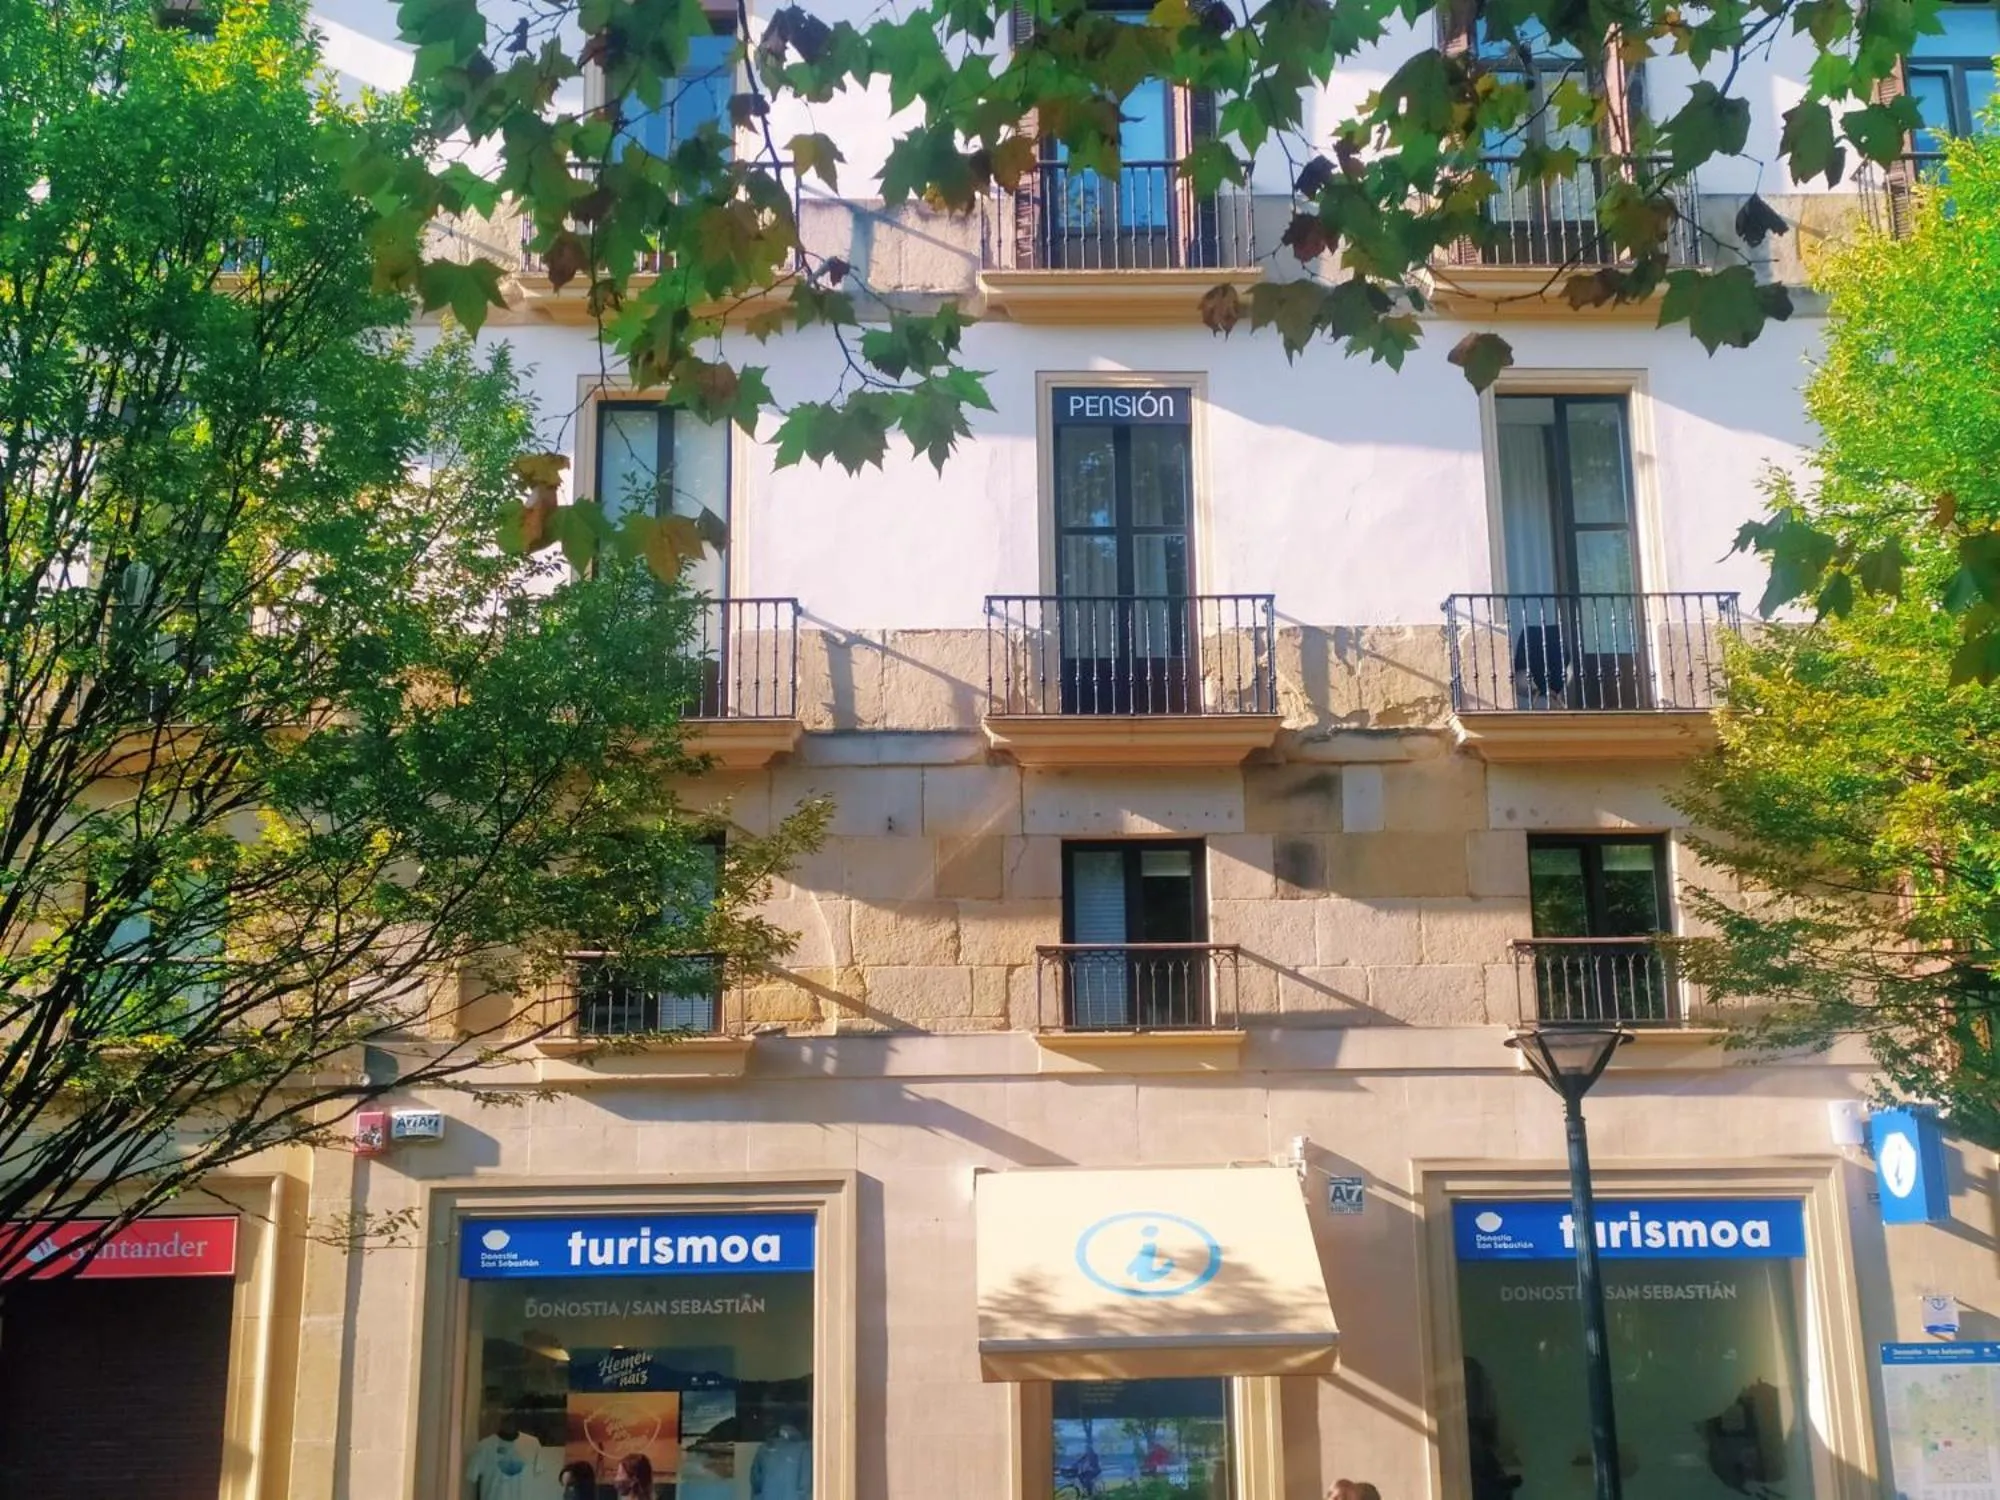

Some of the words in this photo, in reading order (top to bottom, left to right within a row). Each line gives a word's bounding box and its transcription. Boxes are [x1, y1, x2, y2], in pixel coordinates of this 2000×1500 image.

[1070, 391, 1174, 417] PENSIÓN
[69, 1231, 208, 1260] Sntander
[567, 1227, 781, 1266] turismoa
[481, 1260, 496, 1268] San
[1605, 1285, 1640, 1301] SAN
[1642, 1281, 1737, 1300] SEBASTIÁN
[525, 1300, 620, 1319] DONOSTIA
[632, 1300, 667, 1316] SAN
[670, 1295, 766, 1315] SEBASTIÁN
